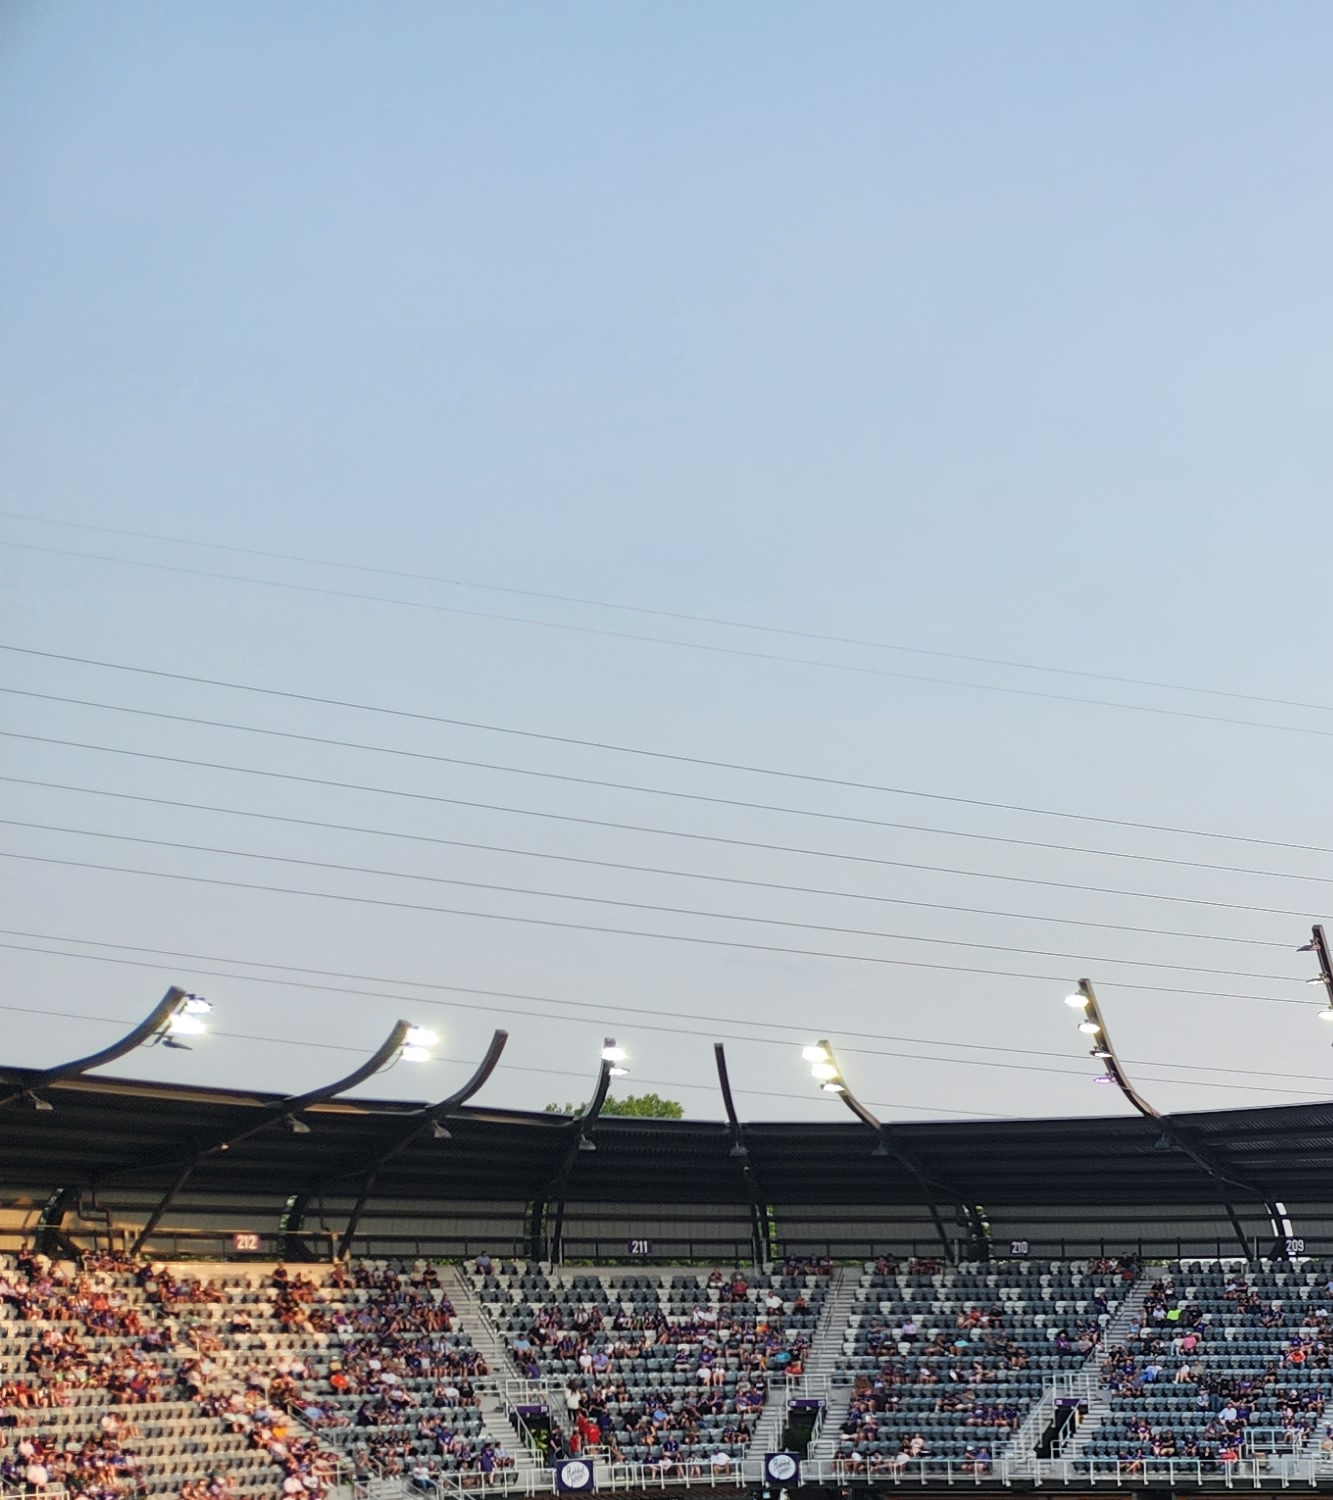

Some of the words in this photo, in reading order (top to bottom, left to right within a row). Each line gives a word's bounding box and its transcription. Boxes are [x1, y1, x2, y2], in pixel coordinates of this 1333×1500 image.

[236, 1234, 258, 1250] 212
[631, 1240, 648, 1254] 211
[1011, 1241, 1029, 1254] 210
[1285, 1239, 1304, 1252] 209
